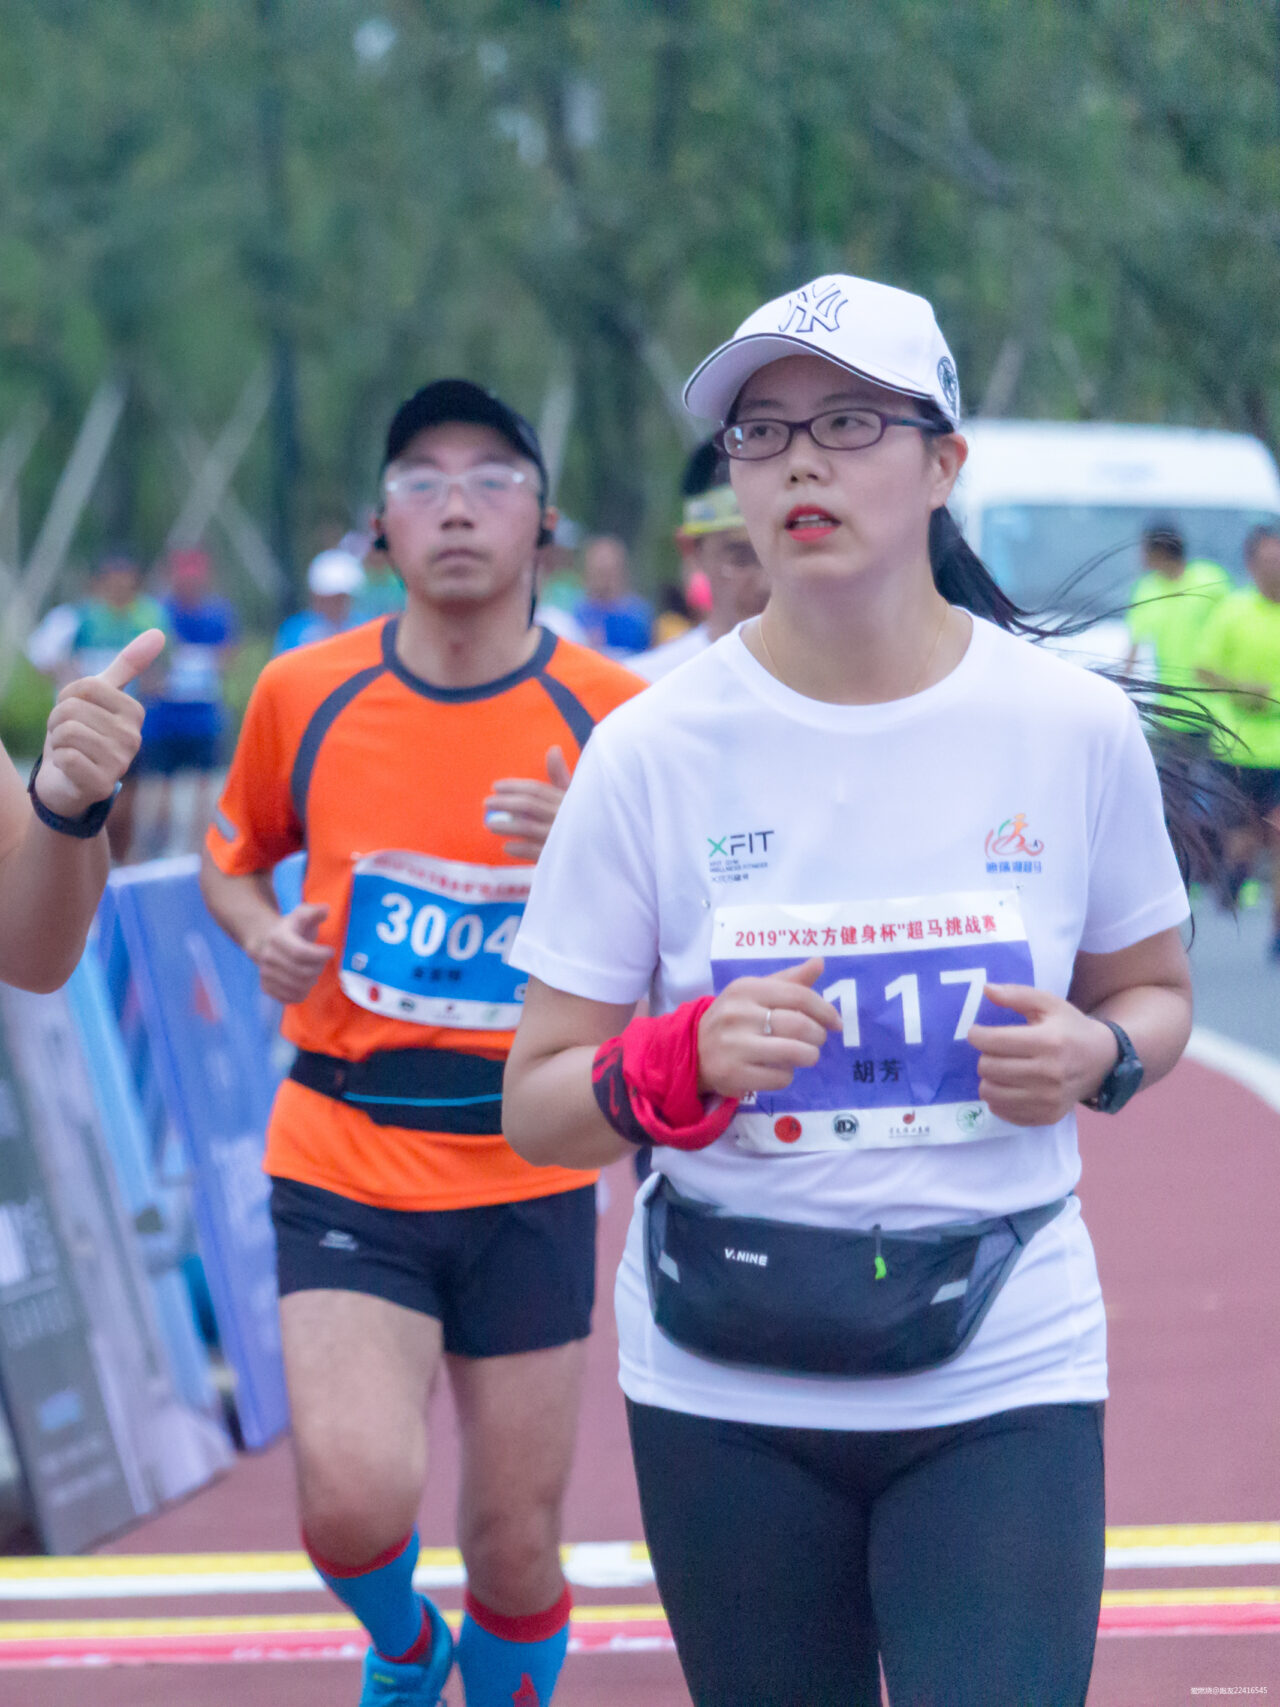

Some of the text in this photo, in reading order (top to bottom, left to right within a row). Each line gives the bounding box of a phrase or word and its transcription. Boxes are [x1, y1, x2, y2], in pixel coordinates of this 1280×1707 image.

[707, 830, 774, 857] XFIT
[376, 893, 523, 965] 3004
[823, 967, 987, 1048] 117
[852, 1059, 903, 1083] 胡芳
[724, 1248, 768, 1266] V.NINE
